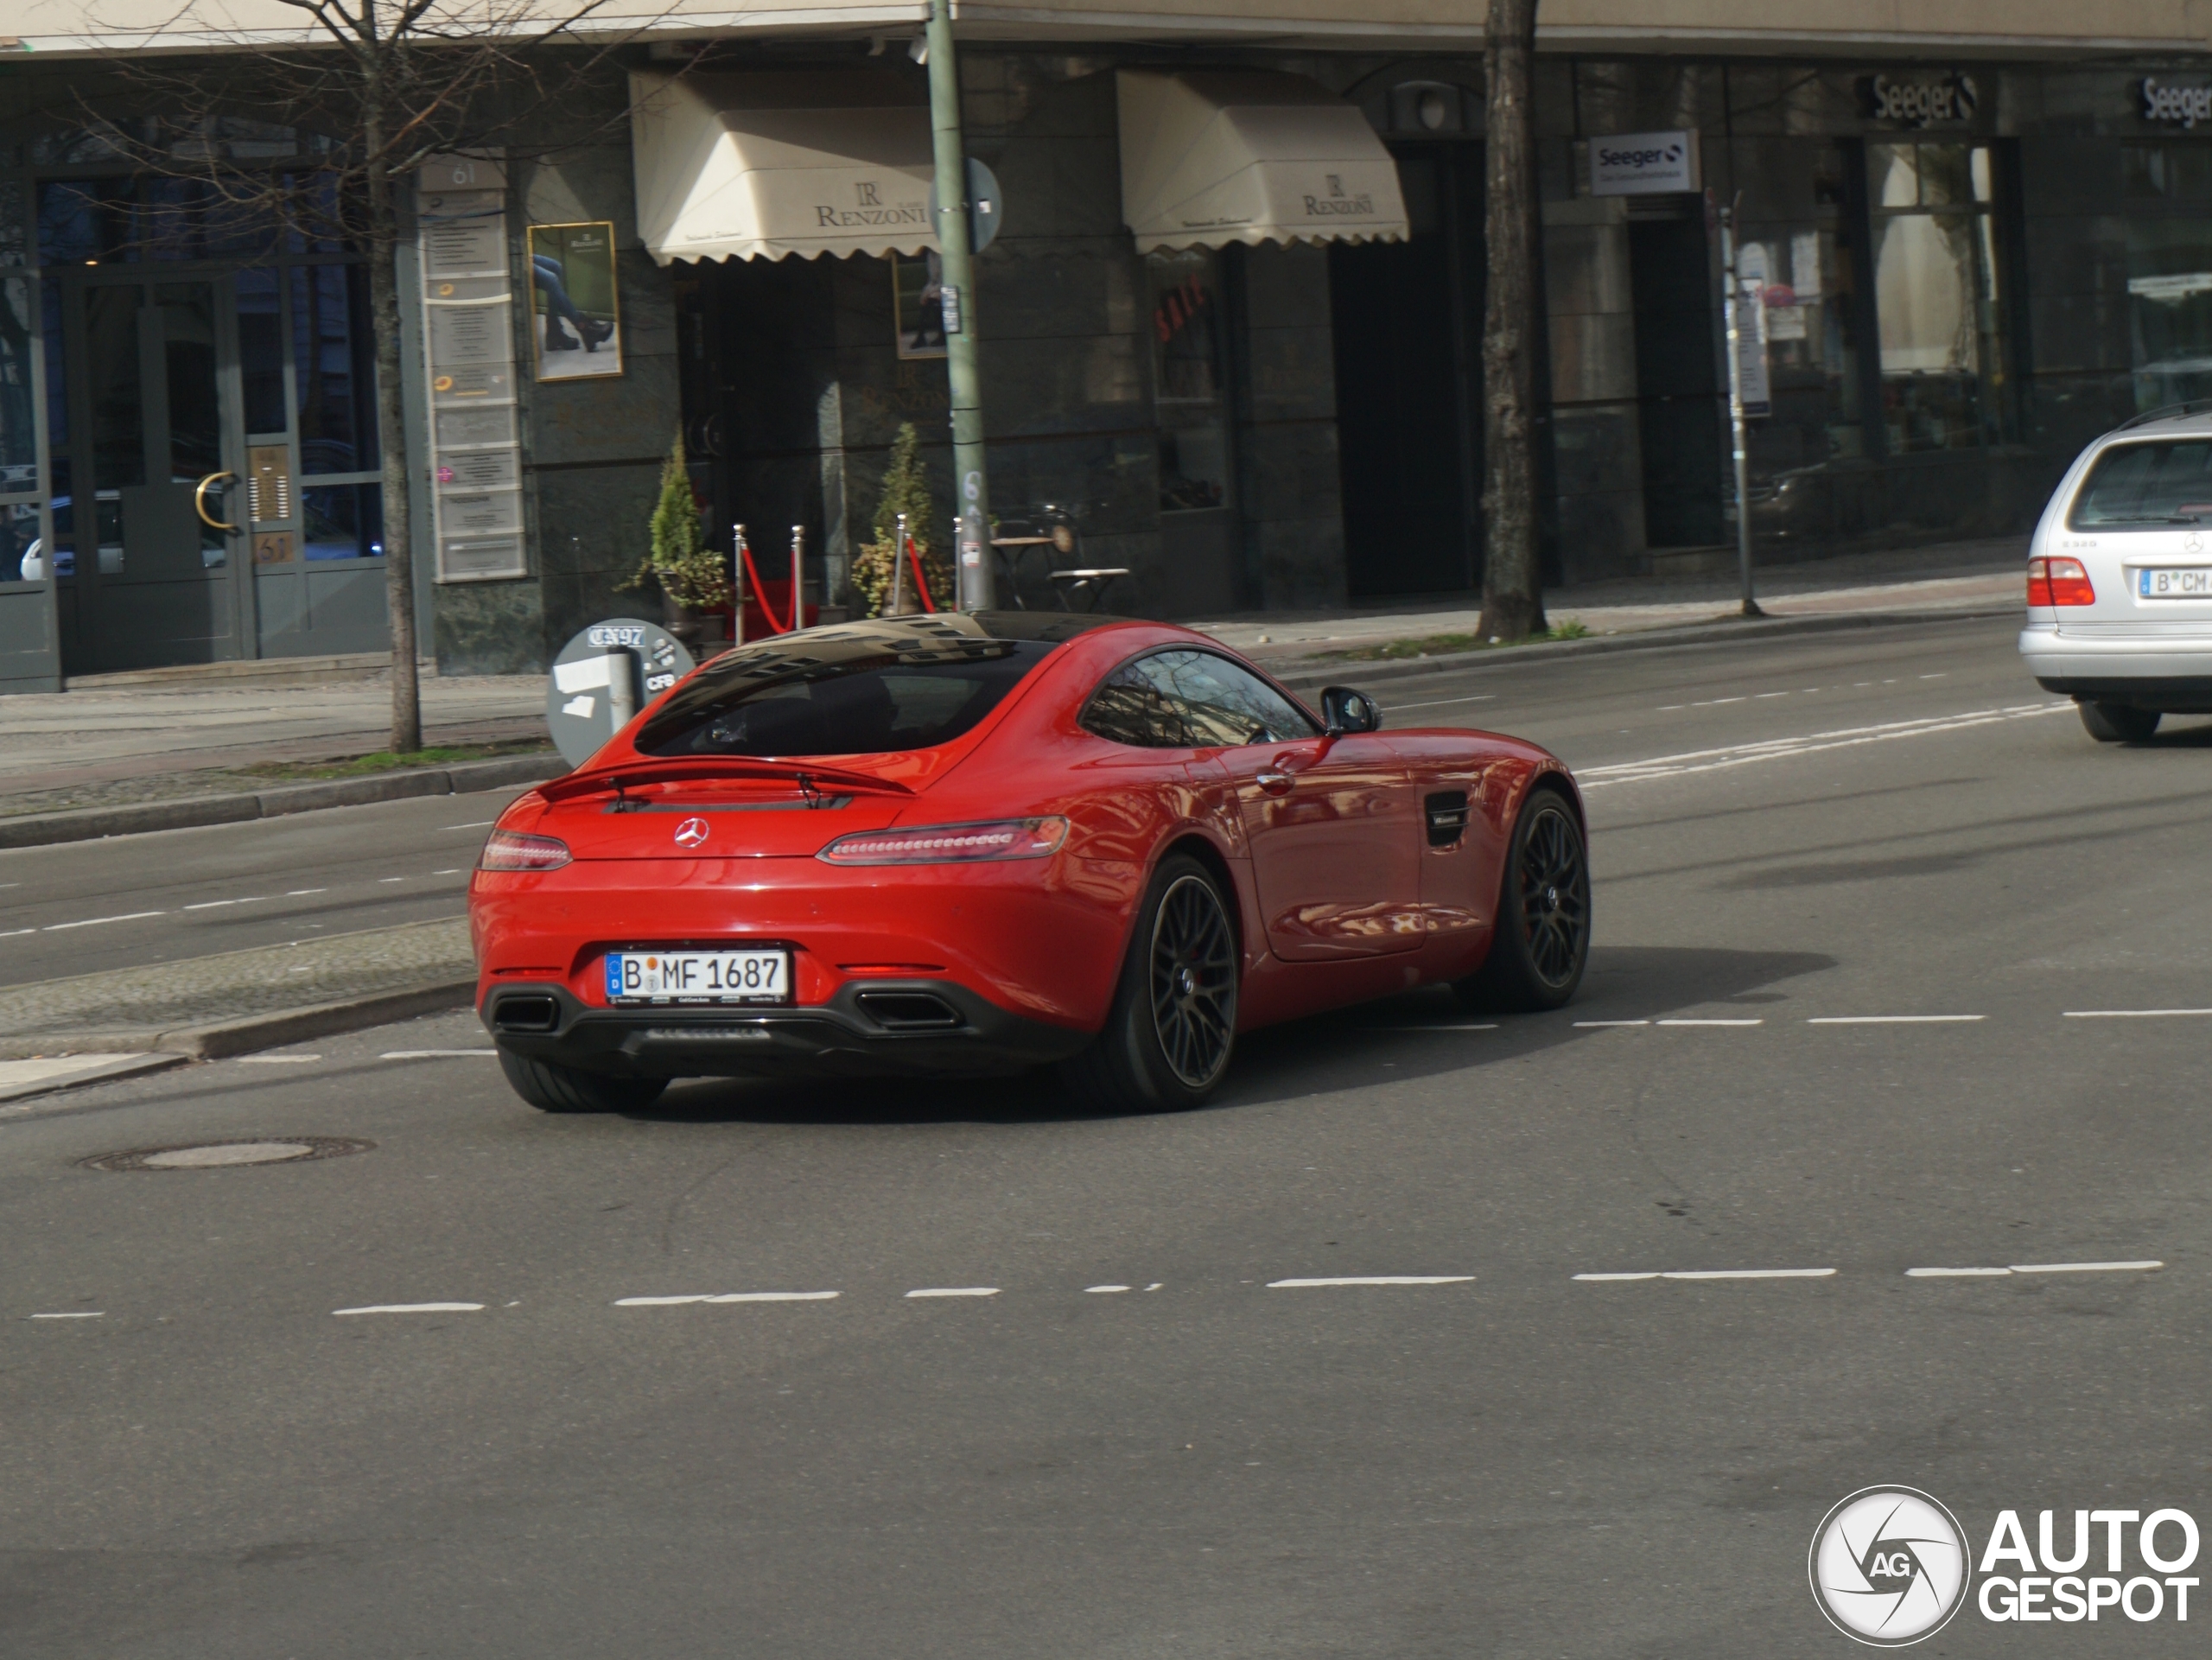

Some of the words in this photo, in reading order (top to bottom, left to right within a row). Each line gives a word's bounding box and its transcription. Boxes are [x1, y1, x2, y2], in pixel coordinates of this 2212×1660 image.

[1874, 75, 1955, 128] Seeger
[2143, 77, 2212, 129] Seeger
[1599, 149, 1662, 168] Seeger
[452, 163, 475, 184] 61
[1303, 194, 1374, 215] RENZONI
[814, 206, 927, 226] RENZONI
[257, 537, 286, 561] 61
[2158, 574, 2169, 592] B
[2182, 573, 2206, 591] CM
[612, 979, 620, 989] D
[624, 959, 641, 989] B
[663, 959, 698, 989] MF
[707, 958, 779, 989] 1687
